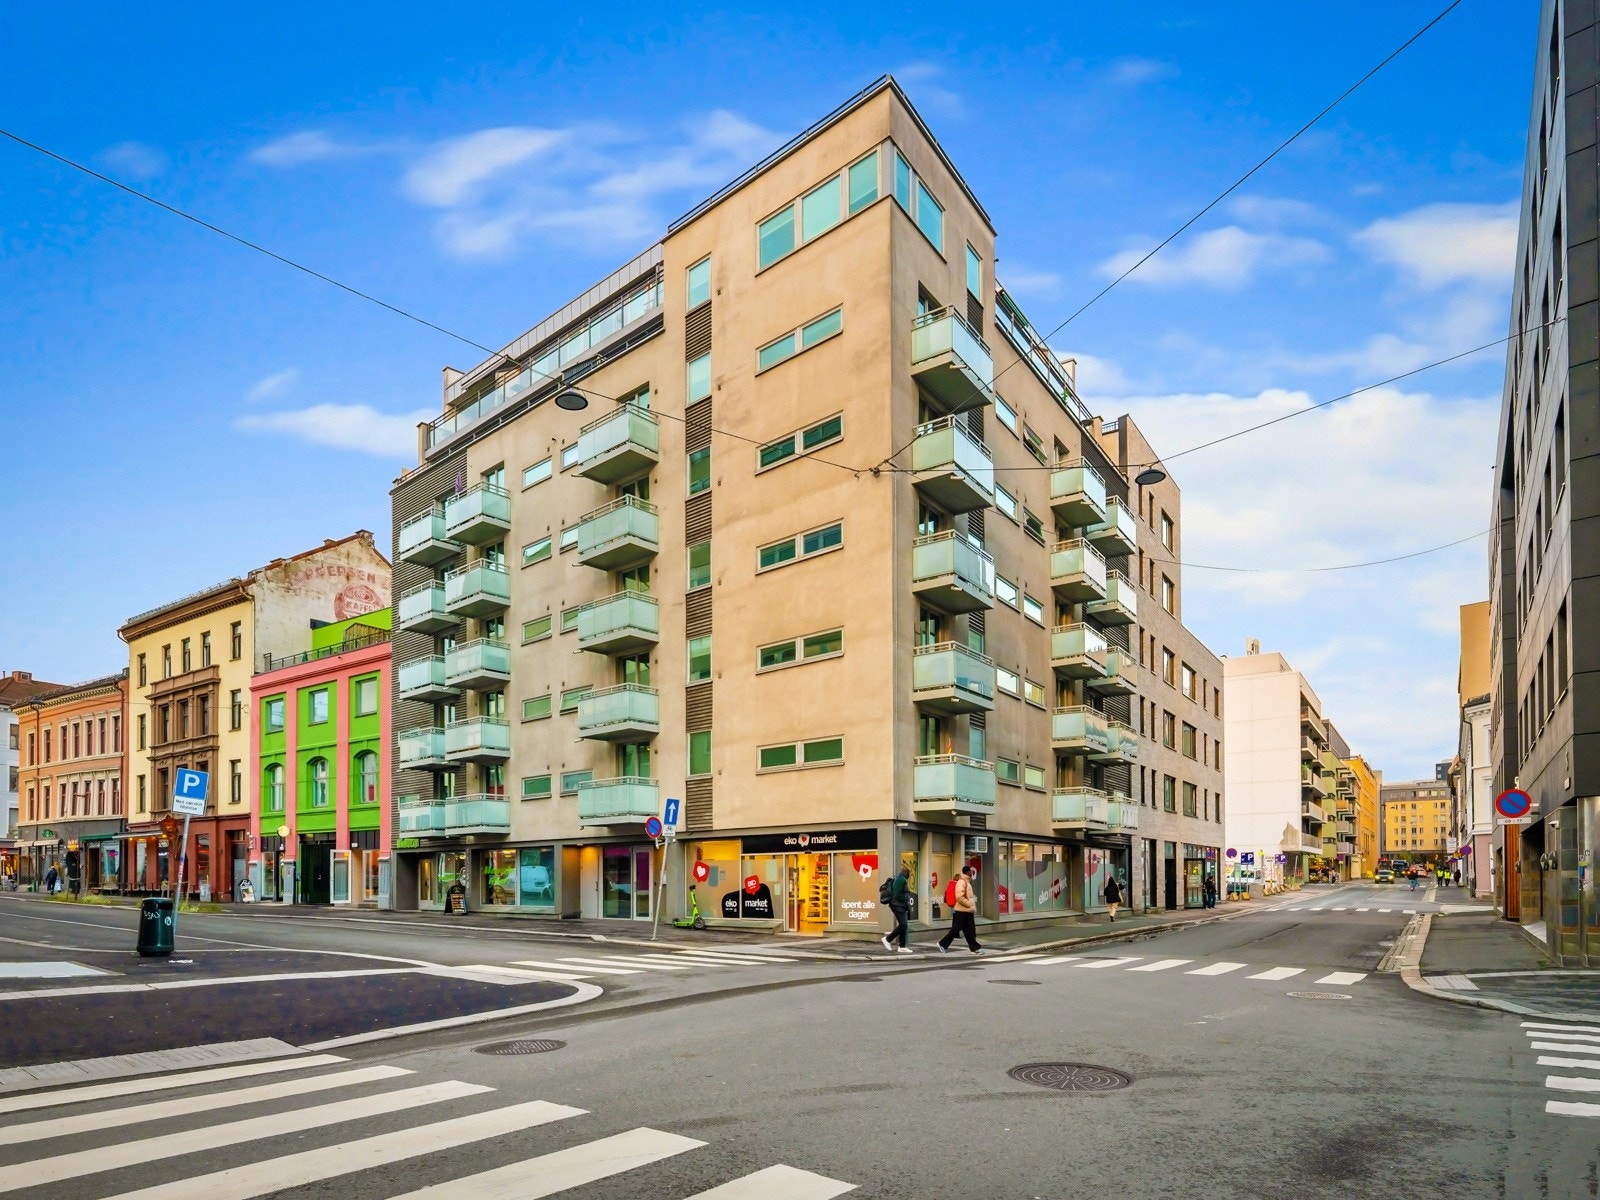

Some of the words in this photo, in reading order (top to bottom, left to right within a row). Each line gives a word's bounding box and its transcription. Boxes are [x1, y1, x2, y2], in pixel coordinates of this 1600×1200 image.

[182, 773, 200, 793] P
[784, 836, 797, 845] eko
[811, 834, 837, 844] market
[1247, 853, 1253, 861] P
[1038, 889, 1049, 905] eko
[725, 898, 738, 908] eko
[744, 898, 768, 908] market
[841, 899, 862, 910] åpent
[862, 900, 876, 909] alle
[848, 909, 870, 920] dager
